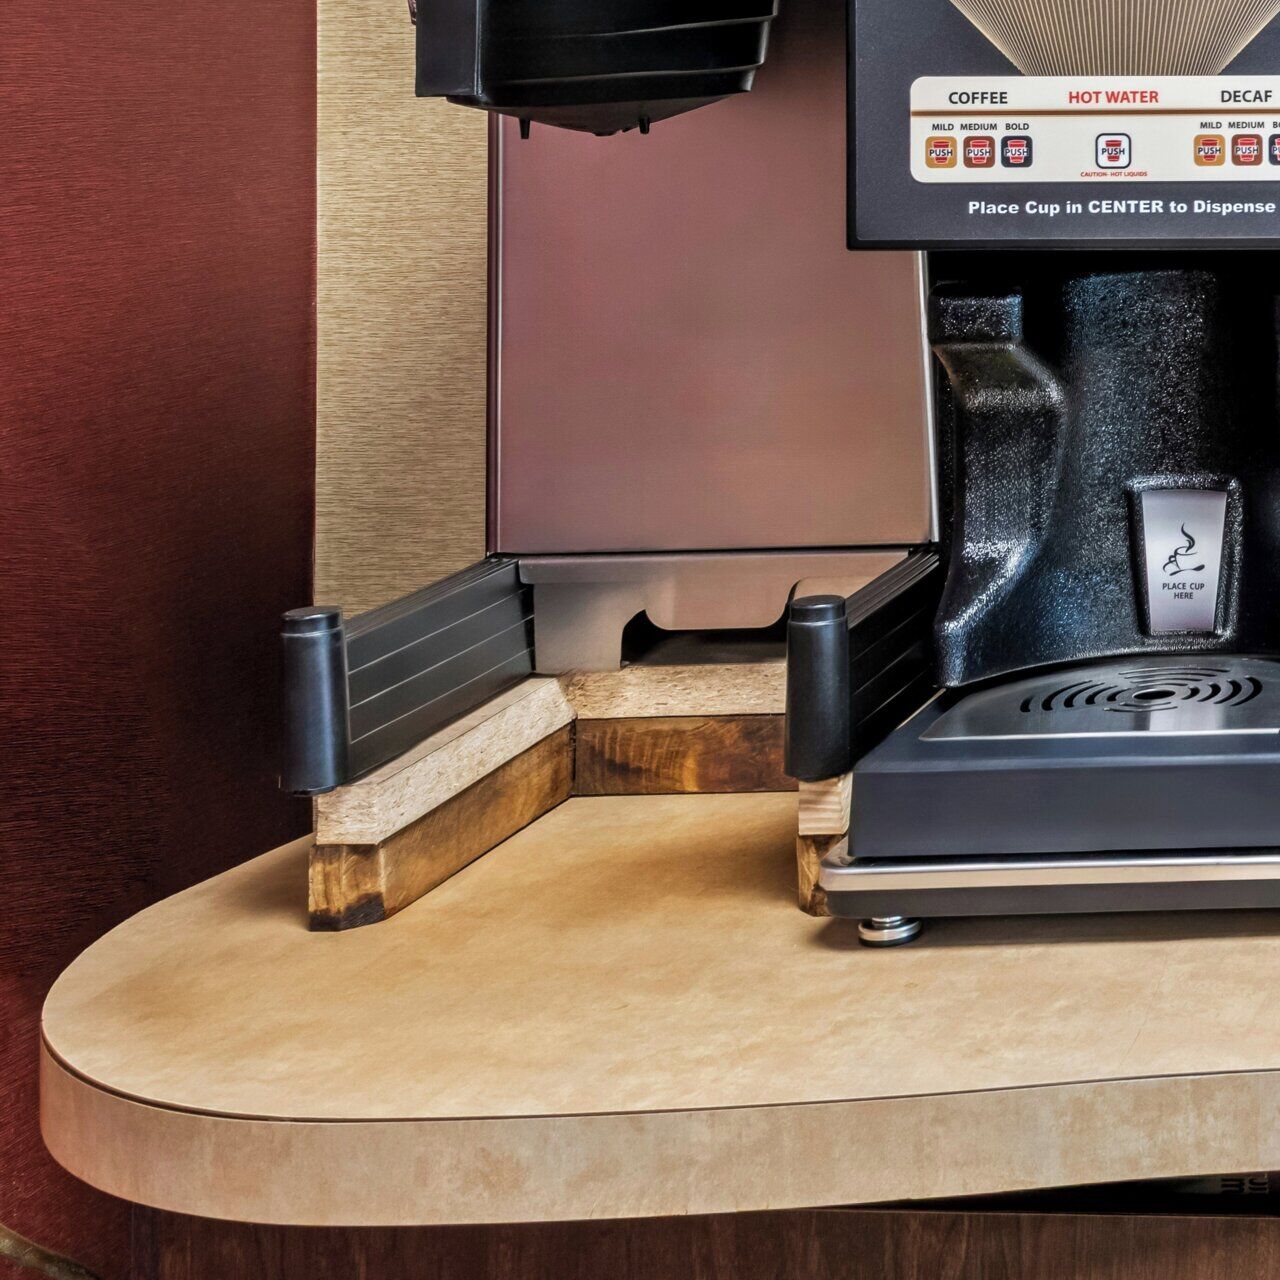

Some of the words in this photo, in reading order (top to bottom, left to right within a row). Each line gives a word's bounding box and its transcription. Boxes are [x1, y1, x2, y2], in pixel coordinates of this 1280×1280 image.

[948, 91, 1008, 105] COFFEE
[1068, 91, 1101, 104] HOT
[1105, 91, 1159, 104] WATER
[1220, 90, 1273, 103] DECAF
[932, 123, 954, 131] MILD
[960, 123, 998, 131] MEDIUM
[1005, 123, 1030, 131] BOLD
[1199, 121, 1222, 129] MILD
[1228, 121, 1265, 129] MEDIUM
[929, 148, 953, 157] PUSH
[966, 148, 991, 157] PUSH
[1004, 148, 1029, 157] PUSH
[1101, 147, 1126, 156] PUSH
[1197, 147, 1222, 155] PUSH
[1235, 146, 1259, 155] PUSH
[968, 200, 1020, 214] Place
[1025, 201, 1060, 217] Cup
[1066, 201, 1082, 213] in
[1088, 200, 1164, 213] CENTER
[1169, 201, 1188, 213] to
[1193, 200, 1276, 216] Dispense
[1162, 582, 1187, 590] PLACE
[1189, 582, 1205, 590] CUP
[1173, 592, 1194, 600] HERE
